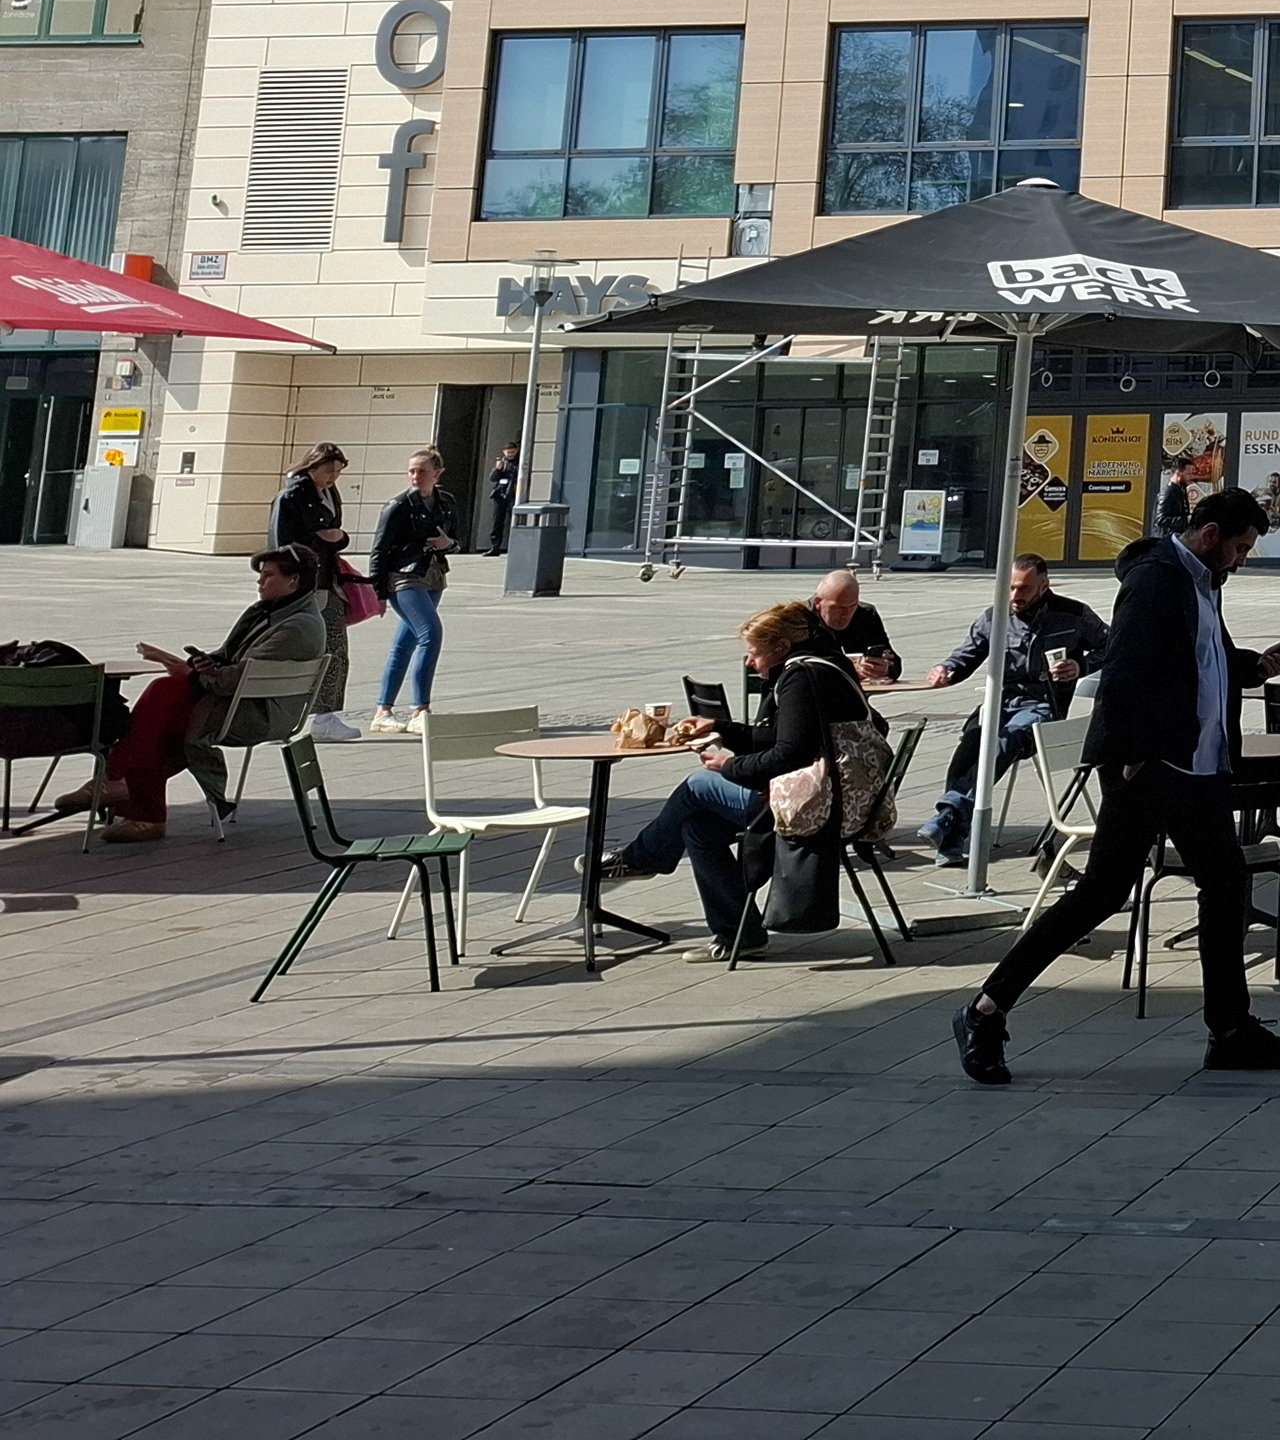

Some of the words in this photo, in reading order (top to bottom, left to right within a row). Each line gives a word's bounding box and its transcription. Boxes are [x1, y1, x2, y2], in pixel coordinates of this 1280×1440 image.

[999, 262, 1178, 295] back
[496, 274, 651, 317] HAYS
[996, 280, 1200, 313] WERK
